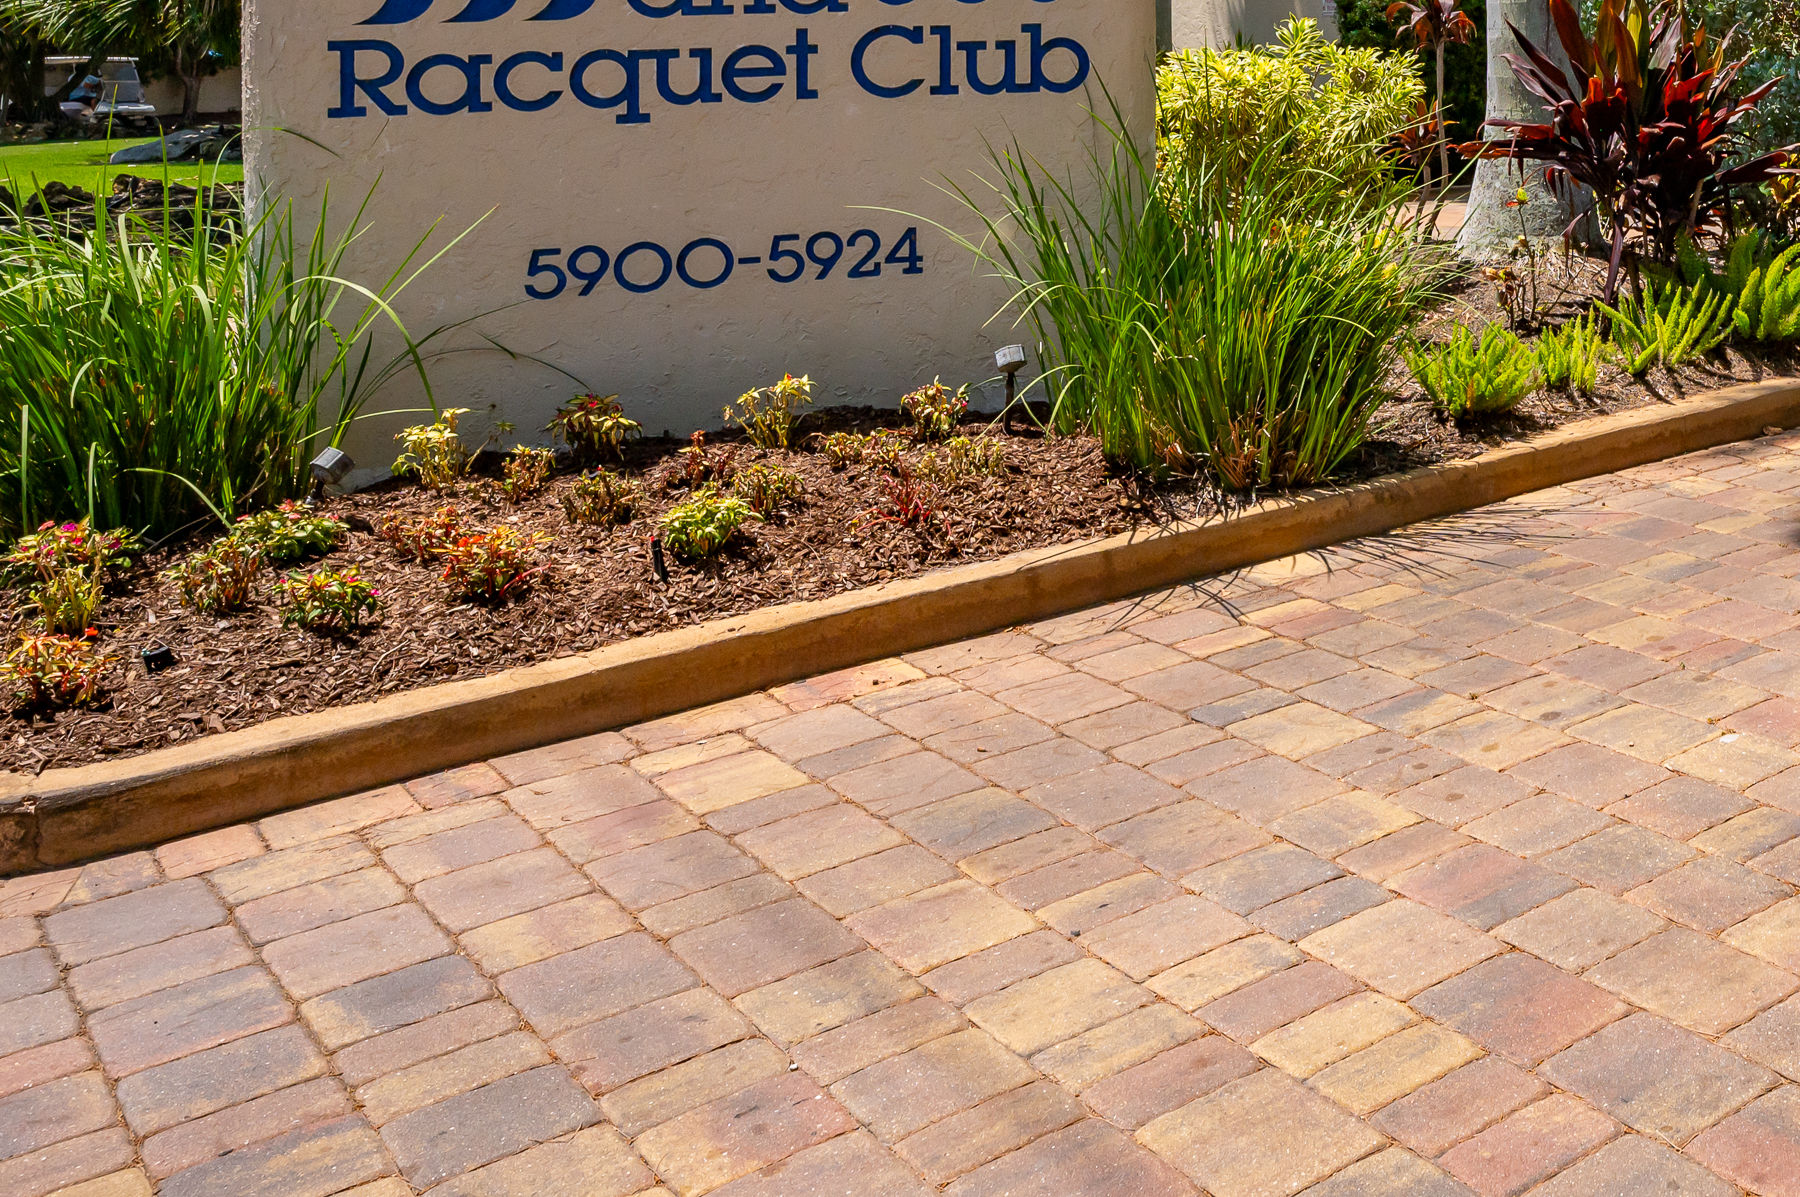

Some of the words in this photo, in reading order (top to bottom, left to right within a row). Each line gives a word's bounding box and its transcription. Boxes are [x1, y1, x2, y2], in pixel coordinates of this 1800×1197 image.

[328, 30, 818, 124] Racquet
[852, 24, 1090, 98] Club
[525, 228, 923, 300] 5900-5924
